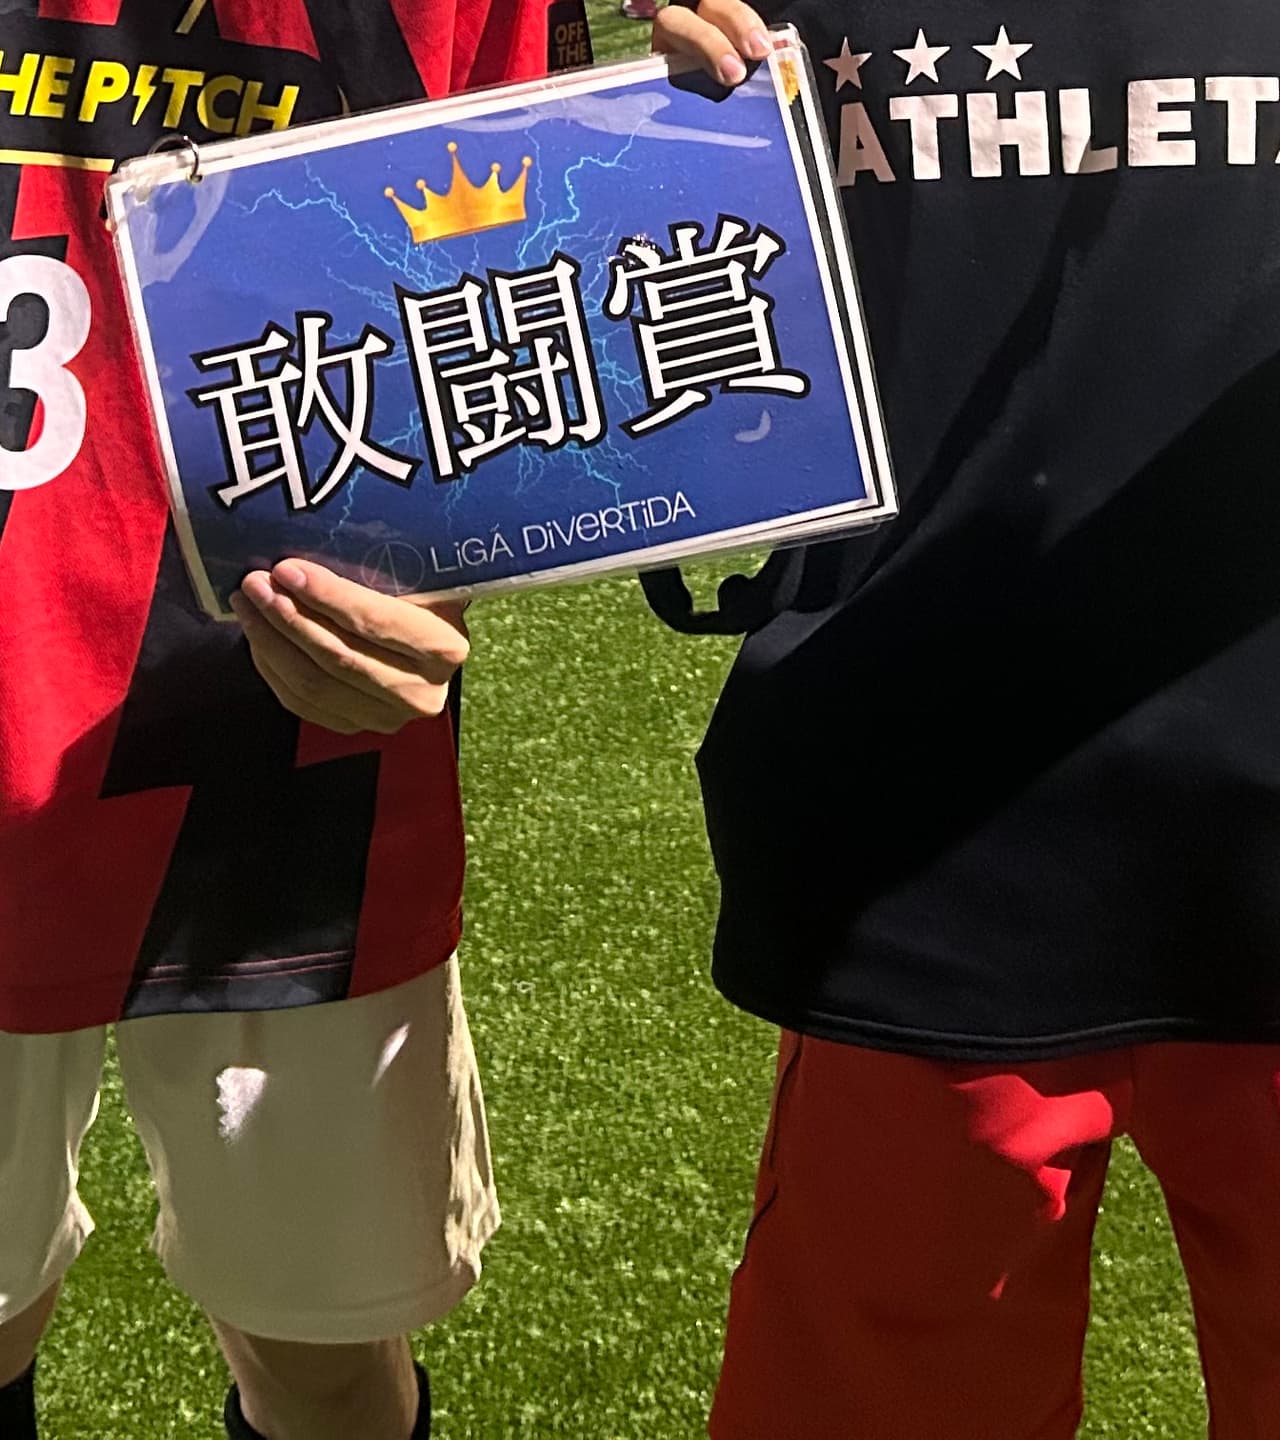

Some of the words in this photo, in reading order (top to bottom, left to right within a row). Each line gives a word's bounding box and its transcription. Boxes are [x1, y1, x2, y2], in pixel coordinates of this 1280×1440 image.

[554, 21, 585, 44] OFF
[557, 42, 588, 65] THE
[78, 60, 300, 136] PITCH
[191, 216, 808, 510] 敢闘賞
